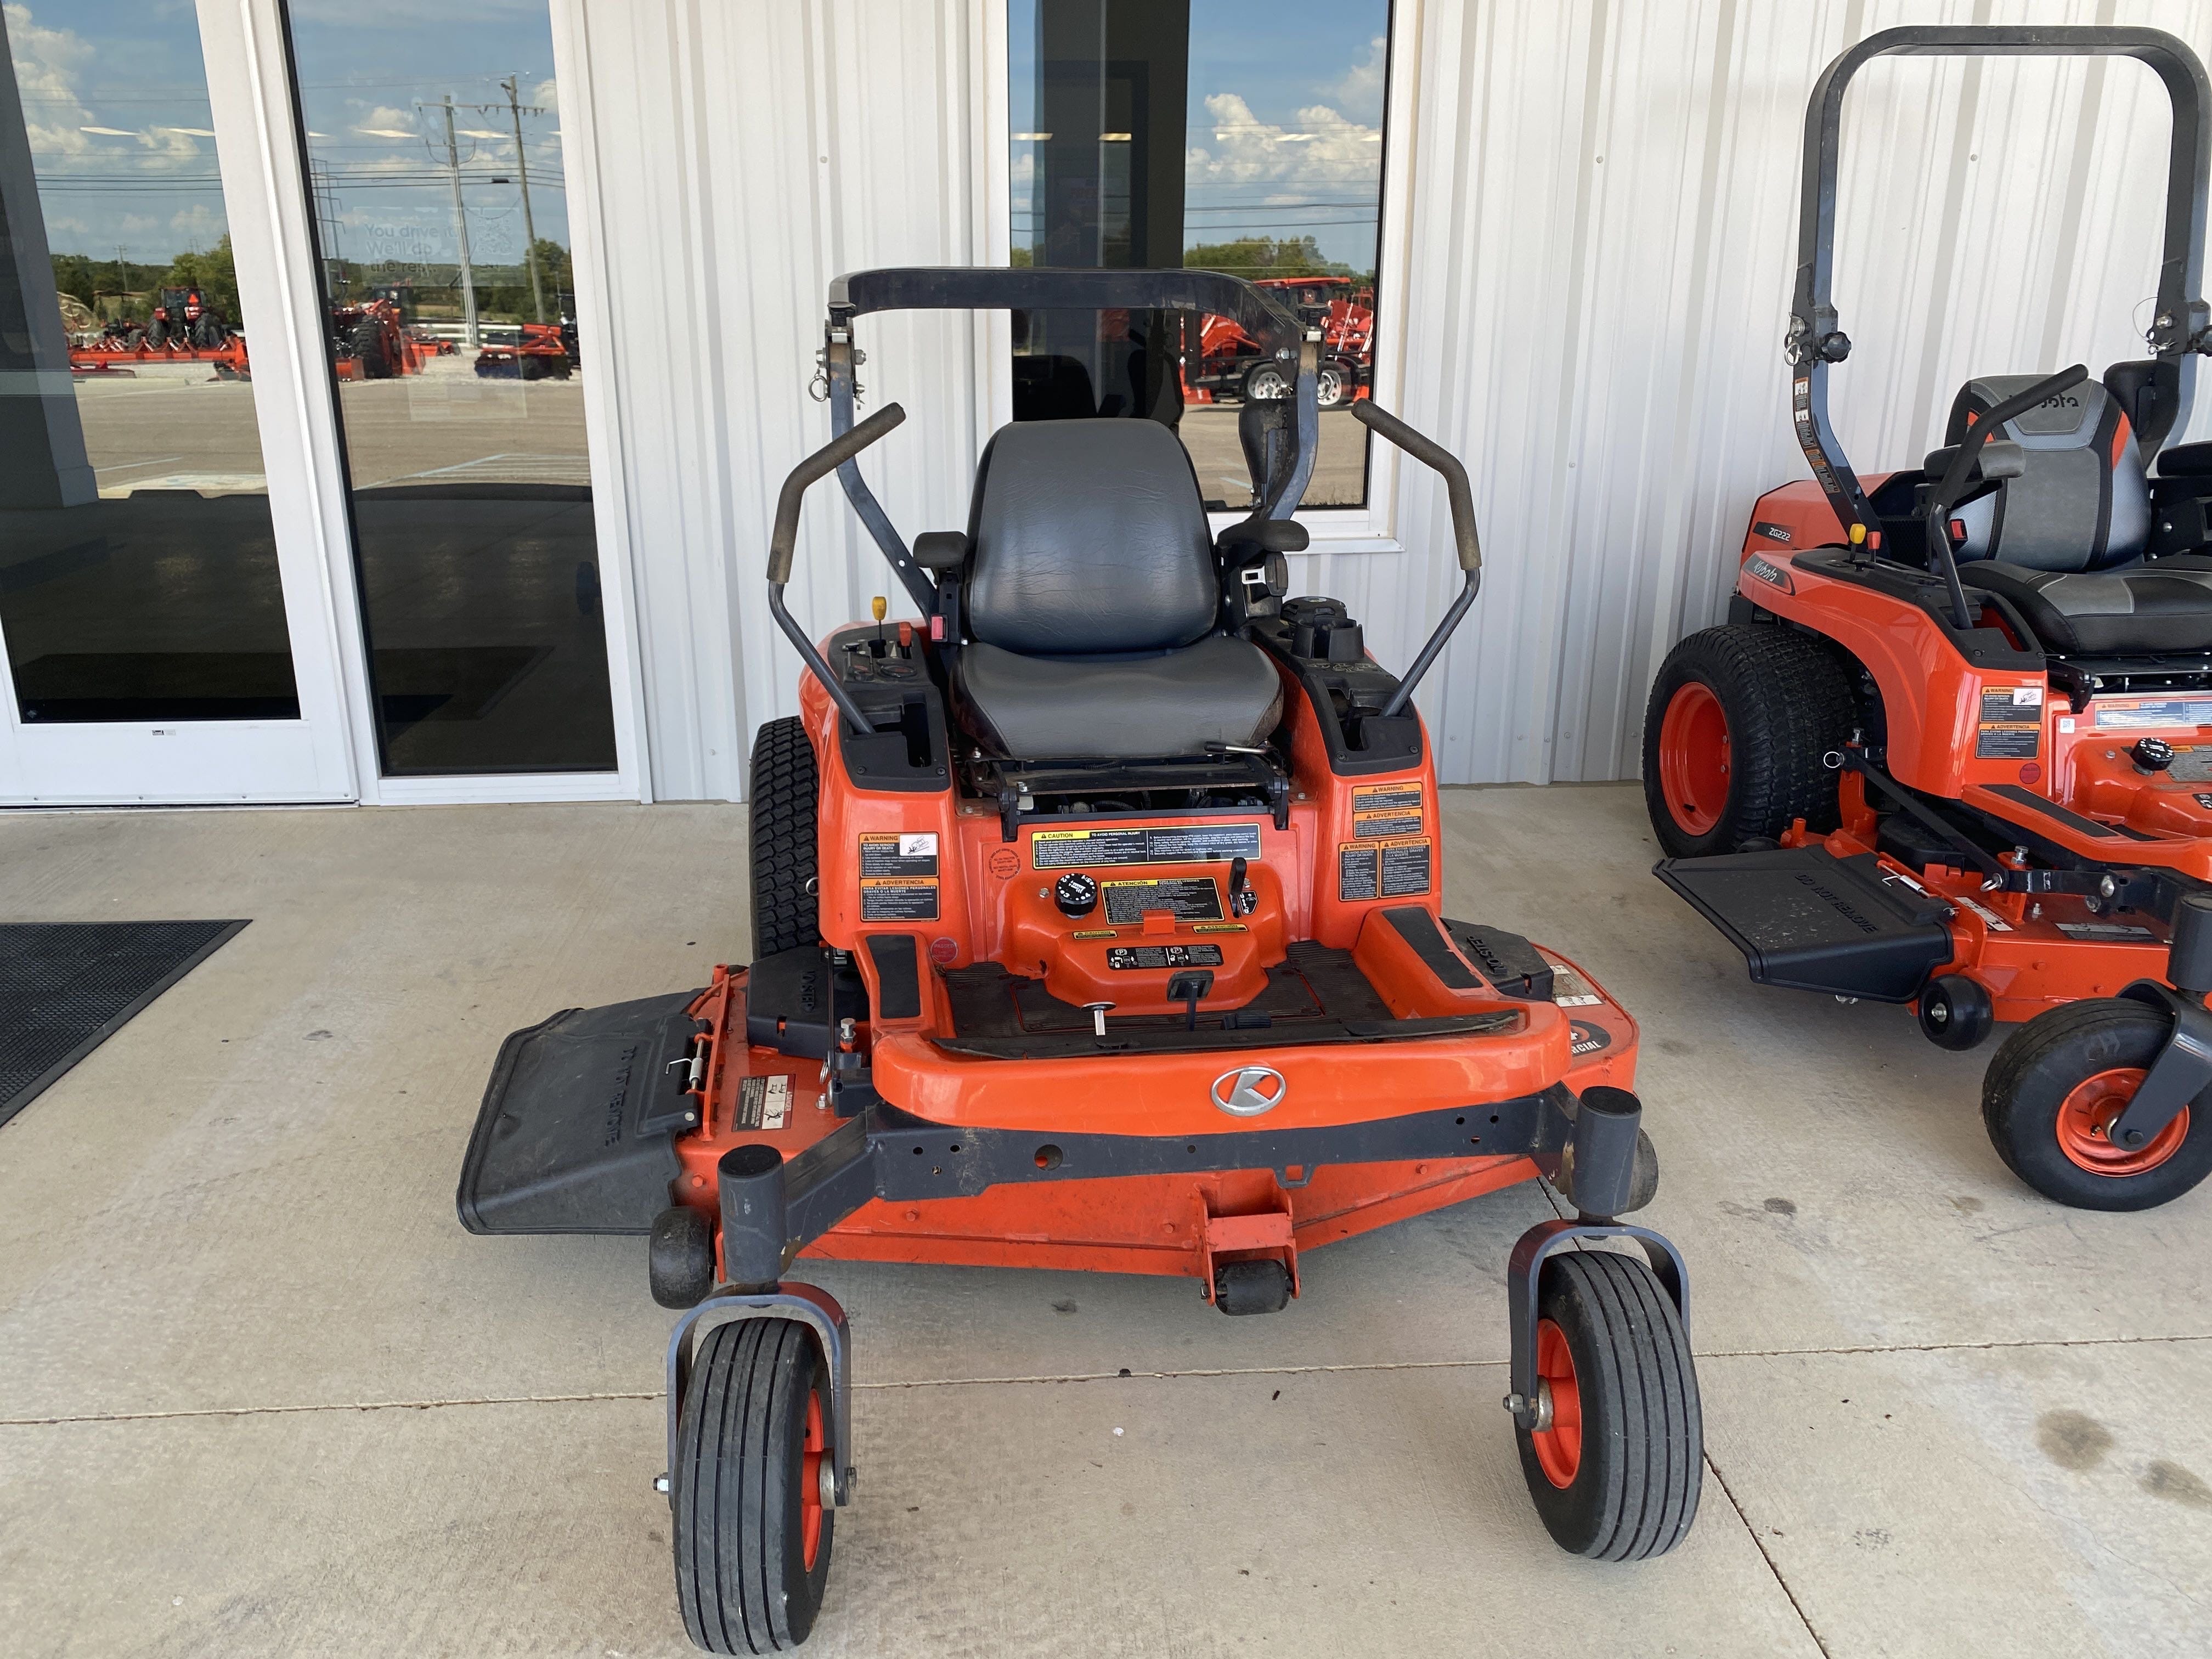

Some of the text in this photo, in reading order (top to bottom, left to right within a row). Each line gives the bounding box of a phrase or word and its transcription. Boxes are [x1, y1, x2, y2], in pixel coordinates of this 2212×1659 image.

[364, 223, 394, 238] You
[399, 224, 438, 238] drive
[411, 241, 432, 255] do
[1768, 527, 1791, 541] ZG222
[1753, 560, 1778, 582] Kubota
[1795, 874, 1878, 933] DO NOT REMOVE
[615, 1064, 631, 1086] NOT
[603, 1089, 627, 1147] REMOVE
